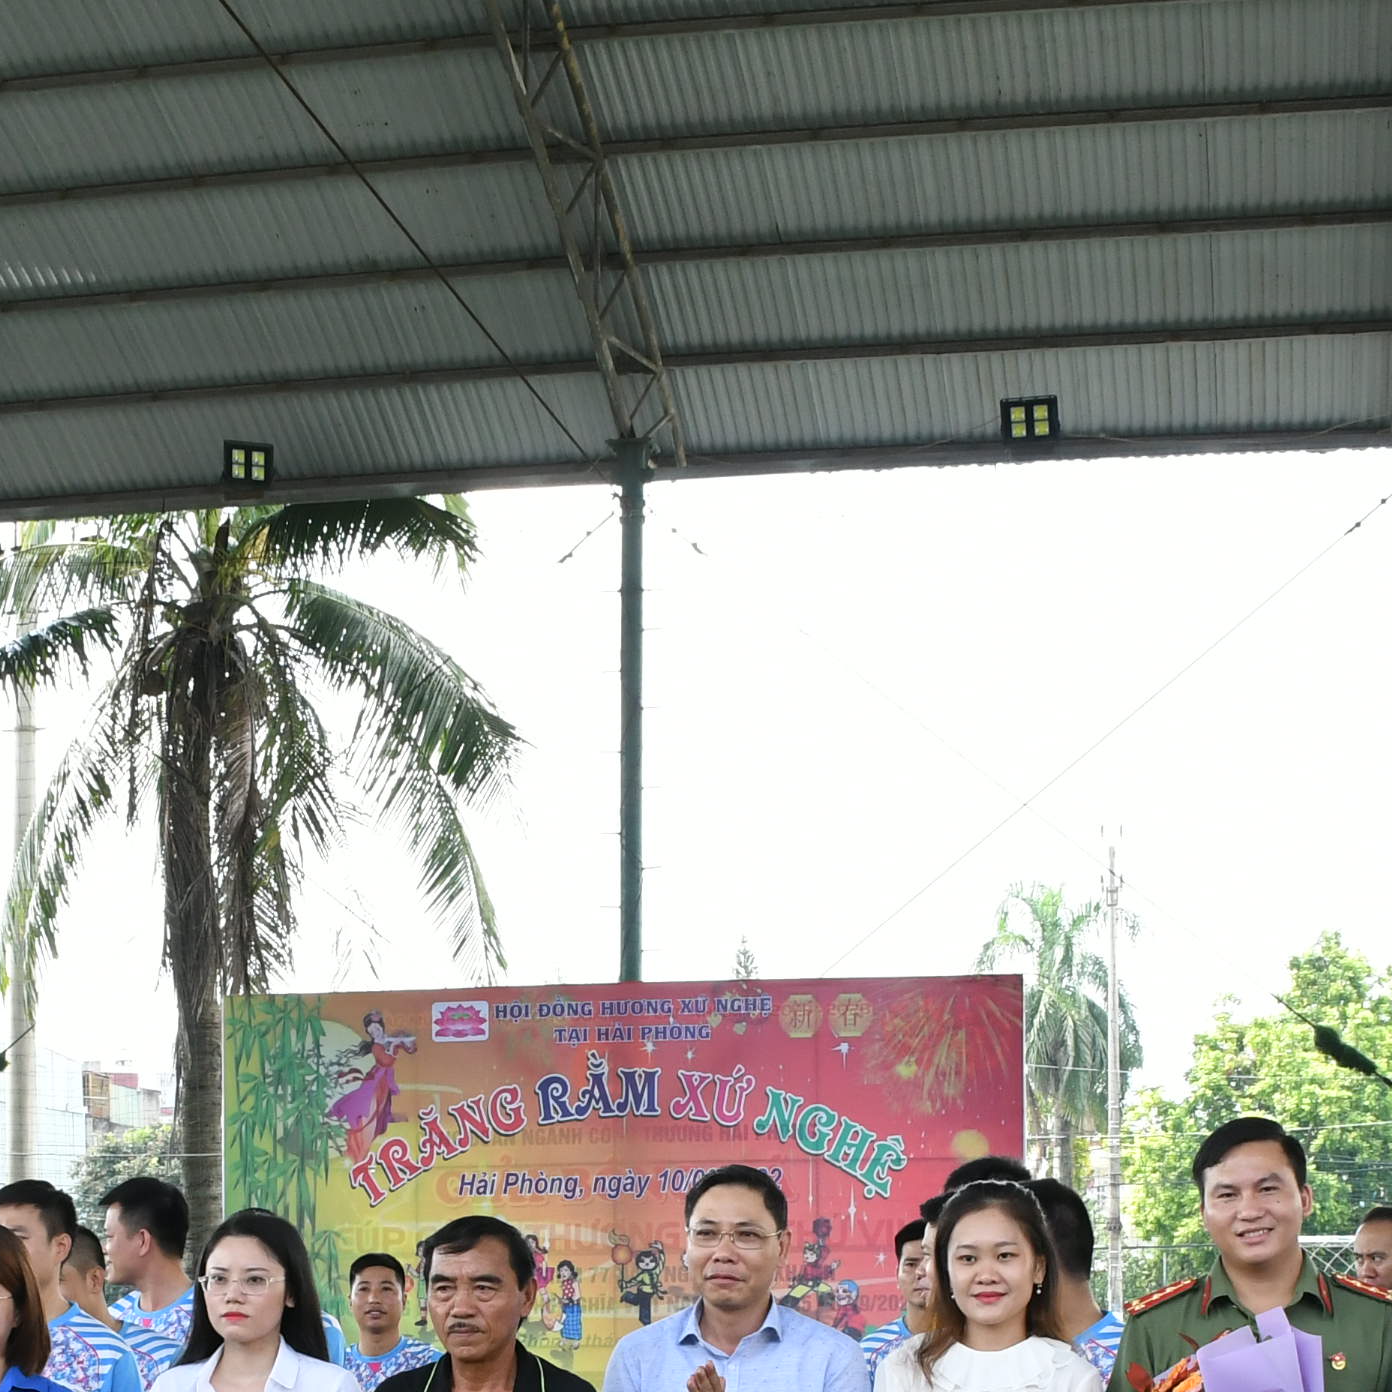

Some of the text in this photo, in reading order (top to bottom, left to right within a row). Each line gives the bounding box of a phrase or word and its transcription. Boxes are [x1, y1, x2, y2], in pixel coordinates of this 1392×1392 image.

[495, 1003, 531, 1023] HỘI
[538, 995, 593, 1018] ĐỒNG
[600, 999, 673, 1016] HƯƠNG
[714, 995, 773, 1018] NGHỆ
[554, 1023, 711, 1047] TẠI HẢI PHÒNG
[350, 1085, 527, 1208] TRĂNG
[536, 1050, 662, 1125] RẰM
[671, 1064, 755, 1126] XỨ
[754, 1086, 908, 1199] NGHỆ
[459, 1171, 496, 1196] Hải
[503, 1172, 584, 1200] Phòng,
[592, 1168, 650, 1199] ngày
